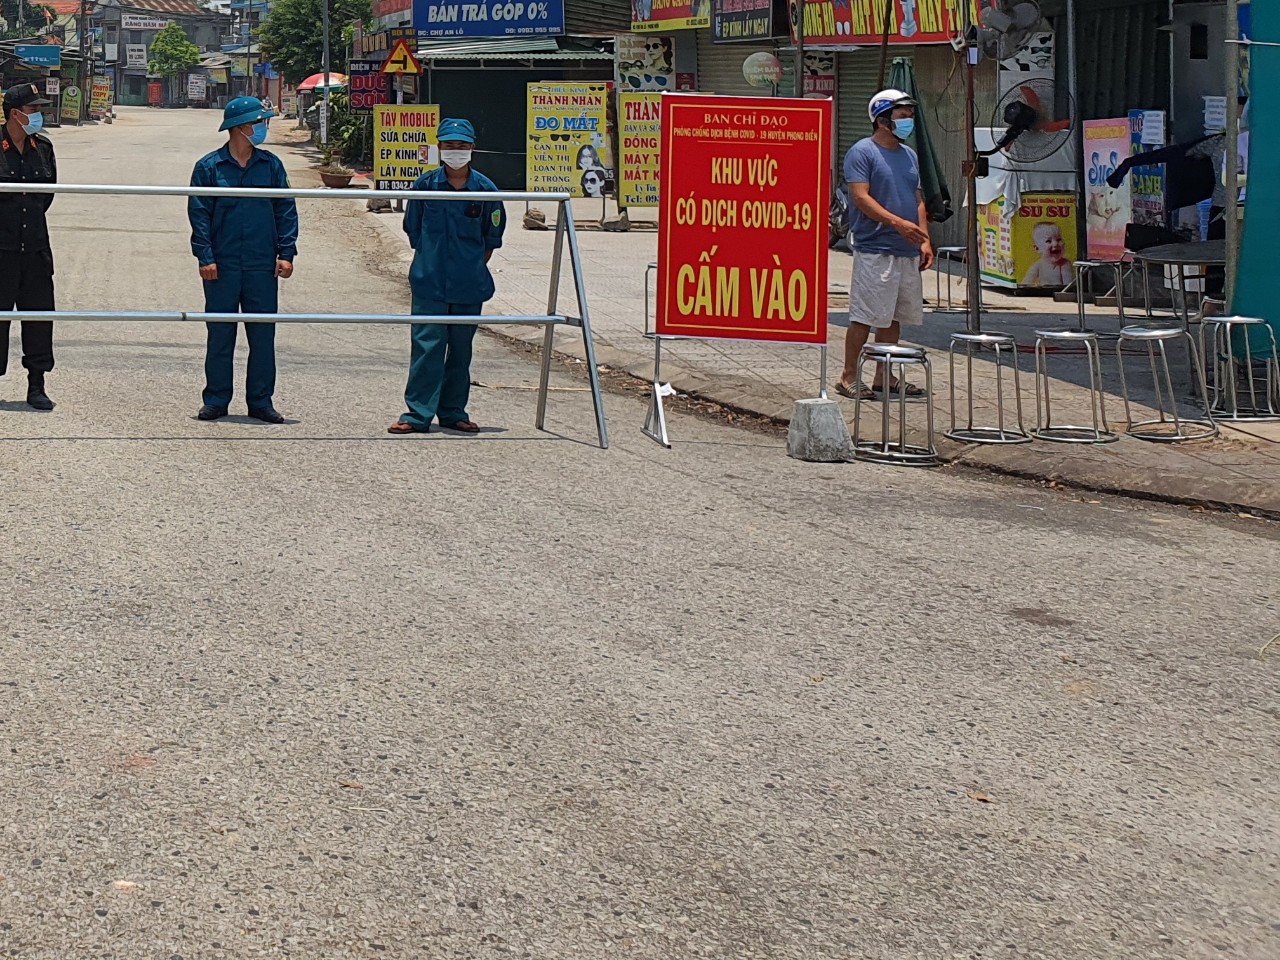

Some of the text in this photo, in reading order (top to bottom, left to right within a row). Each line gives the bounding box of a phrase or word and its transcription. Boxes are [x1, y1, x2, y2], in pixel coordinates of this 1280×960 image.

[428, 0, 458, 23] BÁN
[527, 1, 548, 20] 0%
[350, 62, 370, 72] ĐIỆN
[351, 72, 388, 90] ĐỨC
[350, 90, 388, 107] SƠN
[532, 93, 602, 105] THÀNH NHÂN
[624, 96, 660, 121] THÀN
[380, 109, 436, 127] TÂY MOBILE
[535, 112, 600, 131] ĐO MẮT
[704, 113, 730, 125] BAN
[761, 115, 788, 129] ĐẠO
[381, 128, 427, 143] SỬA CHỮA
[624, 133, 657, 149] ĐỒNG
[673, 125, 692, 137] PHÒNG
[692, 125, 710, 138] CHỐNG
[710, 128, 723, 140] DỊCH
[739, 129, 755, 139] COVID
[760, 130, 767, 140] 19
[786, 131, 804, 141] PHONG
[381, 147, 417, 160] ÉP KÍNH
[624, 151, 649, 165] MÁY
[381, 163, 424, 177] LẤY NGAY
[624, 165, 649, 181] MẮT
[711, 153, 778, 192] KHU VỰC
[624, 194, 643, 203] Tel:
[675, 191, 812, 233] CÓ DỊCH COVID-19
[1019, 206, 1070, 218] SU SU
[676, 245, 809, 322] CẤM VÀO
